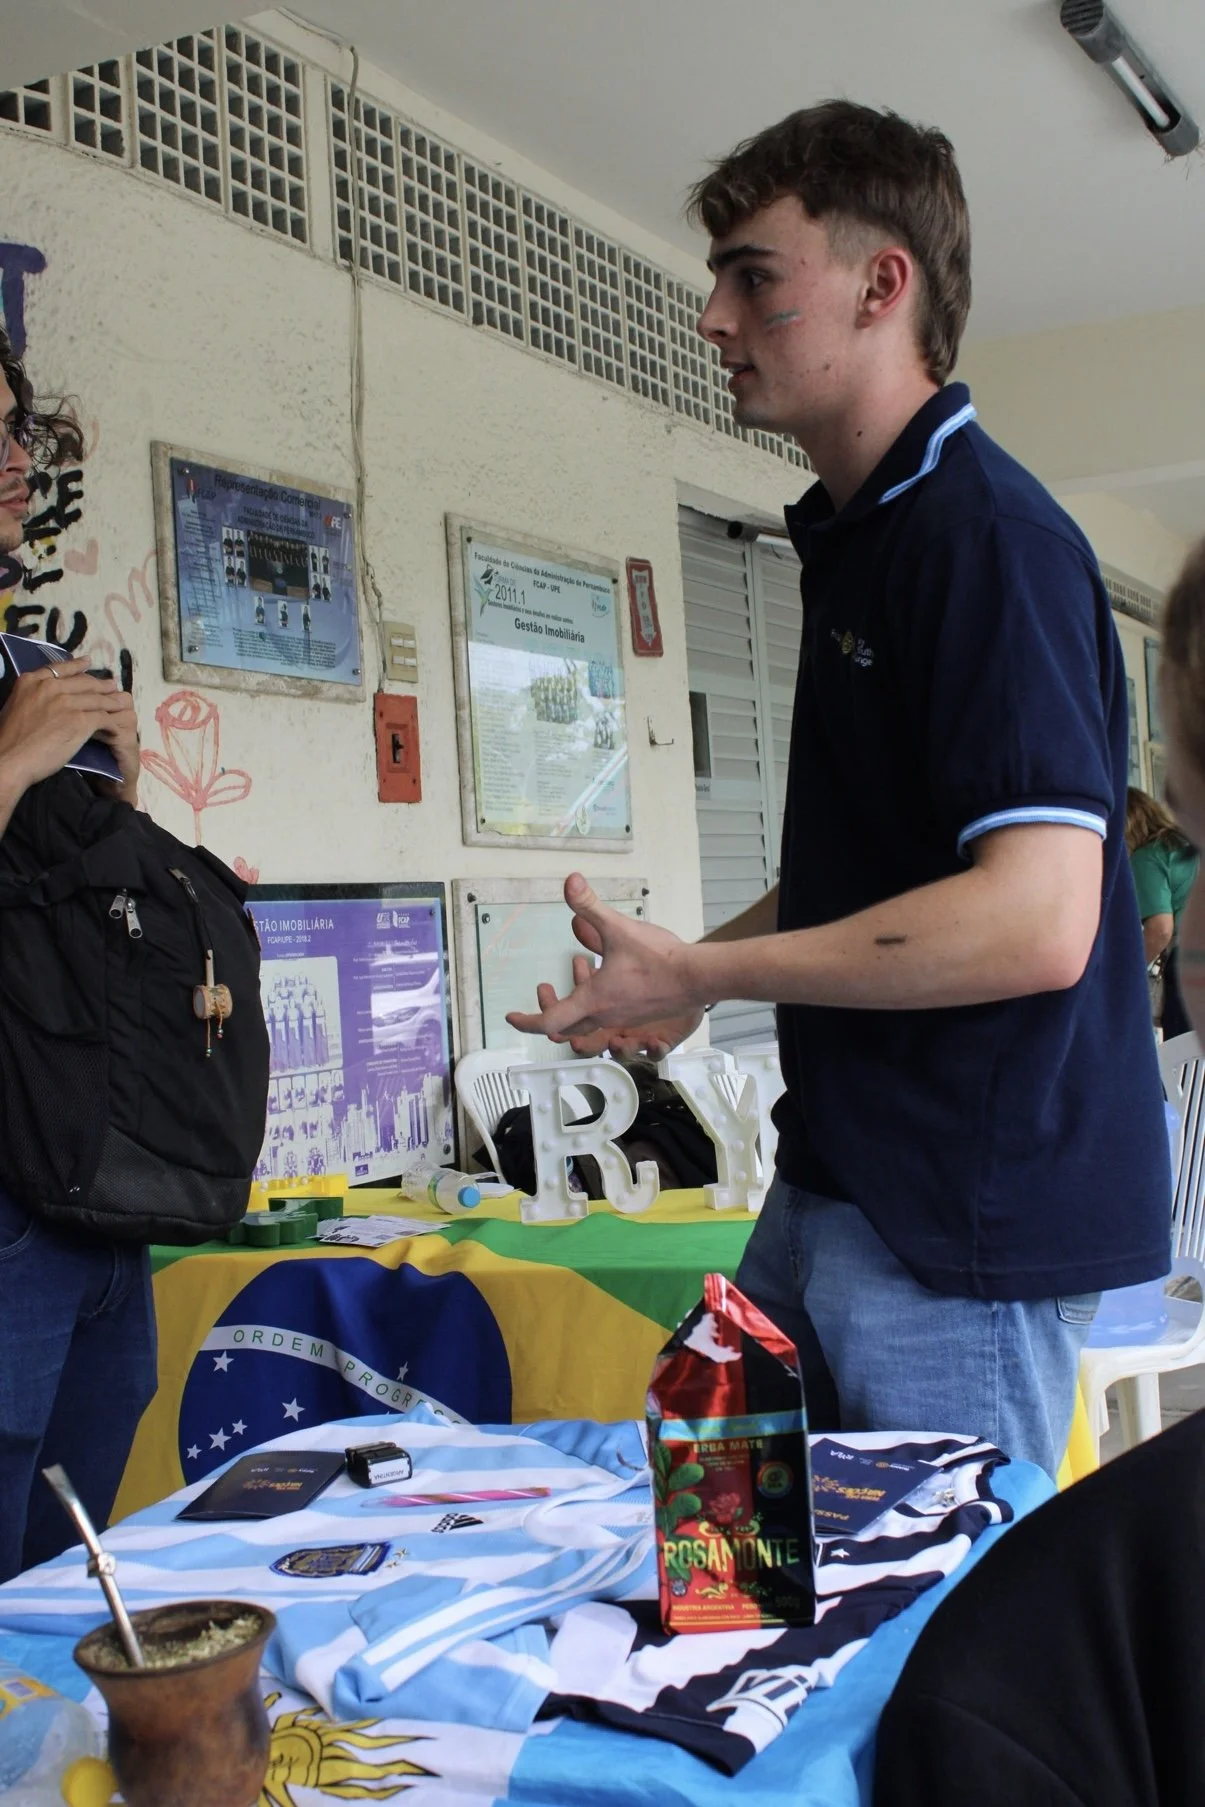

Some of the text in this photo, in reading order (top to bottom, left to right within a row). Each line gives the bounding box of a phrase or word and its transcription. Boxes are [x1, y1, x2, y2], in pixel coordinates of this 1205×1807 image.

[215, 475, 321, 510] Representação Comercial
[474, 551, 502, 567] Faculdade
[511, 561, 533, 574] Ciências
[541, 569, 576, 586] Administração
[582, 580, 611, 594] Pernambuco
[495, 583, 526, 605] 2011.1
[533, 579, 547, 591] FCAP
[550, 583, 561, 594] UPE
[514, 617, 543, 634] Gestão
[545, 624, 585, 643] Imobiliária
[253, 916, 334, 932] STÃO IMOBILIÁRIA
[233, 1329, 462, 1424] ORDEM PROGR
[692, 1439, 764, 1454] ERBA MATE
[373, 1469, 405, 1481] ARGENTINA
[663, 1538, 800, 1572] ROSAMONTE
